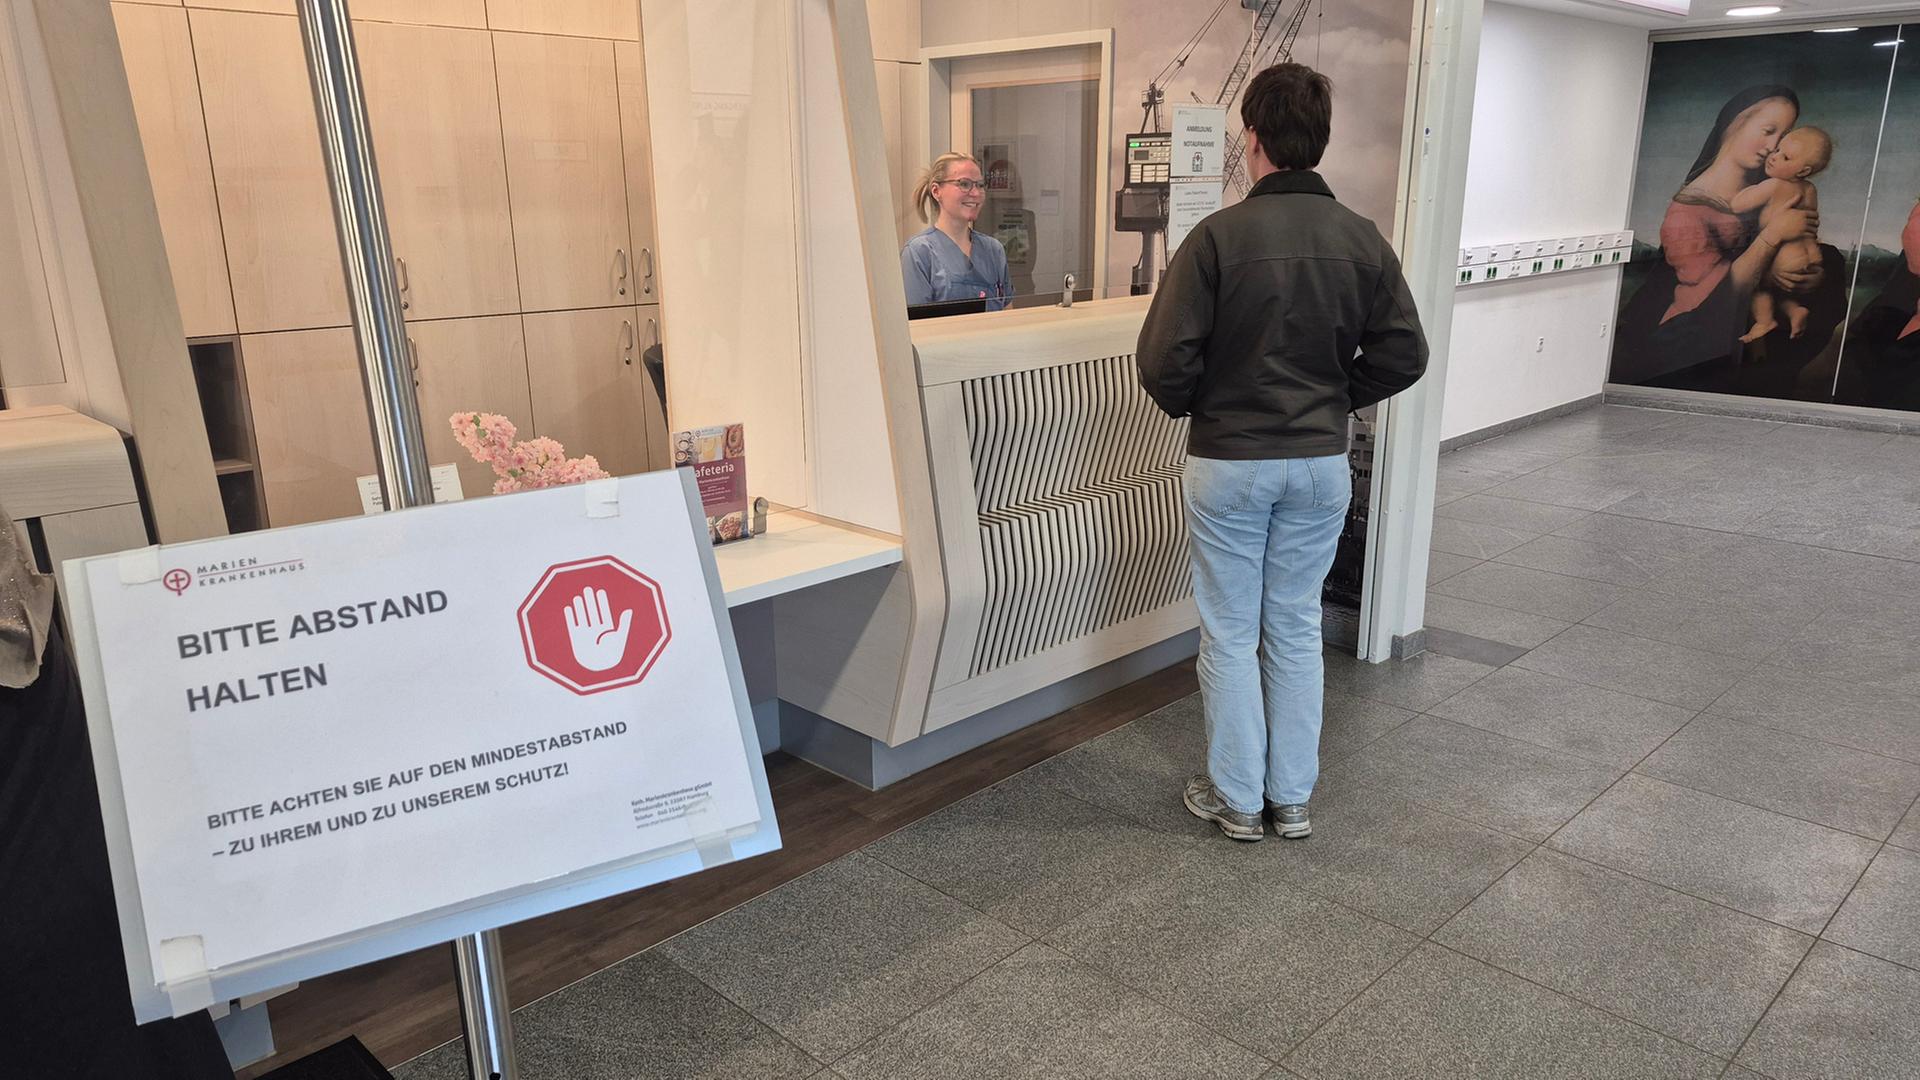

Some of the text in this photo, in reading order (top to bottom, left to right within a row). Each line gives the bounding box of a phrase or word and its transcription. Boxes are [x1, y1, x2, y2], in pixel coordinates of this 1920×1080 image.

[696, 463, 734, 478] afeteria
[196, 556, 258, 575] MARIEN
[198, 562, 306, 587] KRANKENHAUS
[177, 590, 449, 660] BITTE ABSTAND
[186, 663, 328, 713] HALTEN
[207, 721, 628, 830] BITTE ACHTEN SIE AUF DEN MINDESTABSTAND
[228, 836, 255, 856] ZU
[260, 820, 323, 849] IHREM
[327, 810, 368, 832] UND
[371, 802, 397, 822] ZU
[402, 780, 491, 814] UNSEREM
[494, 762, 569, 792] SCHUTZ!
